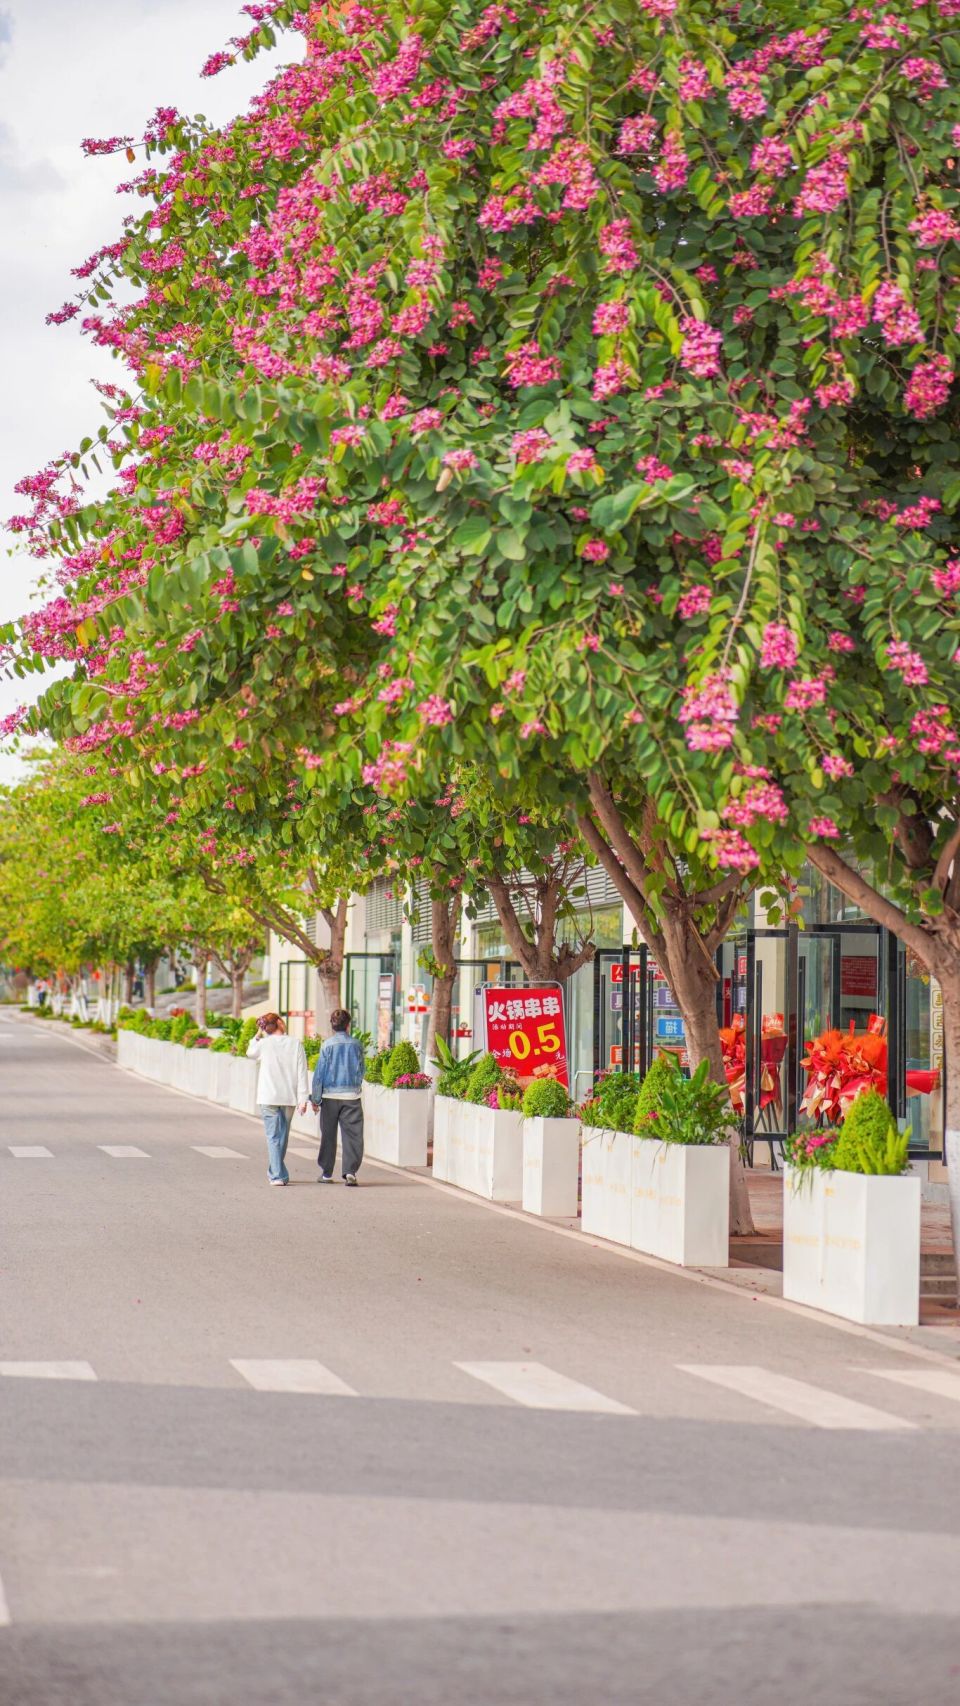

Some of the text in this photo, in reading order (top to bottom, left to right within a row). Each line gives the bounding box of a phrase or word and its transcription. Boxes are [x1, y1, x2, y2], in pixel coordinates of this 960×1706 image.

[488, 996, 560, 1022] 火锅串串
[508, 1022, 560, 1060] 0.5
